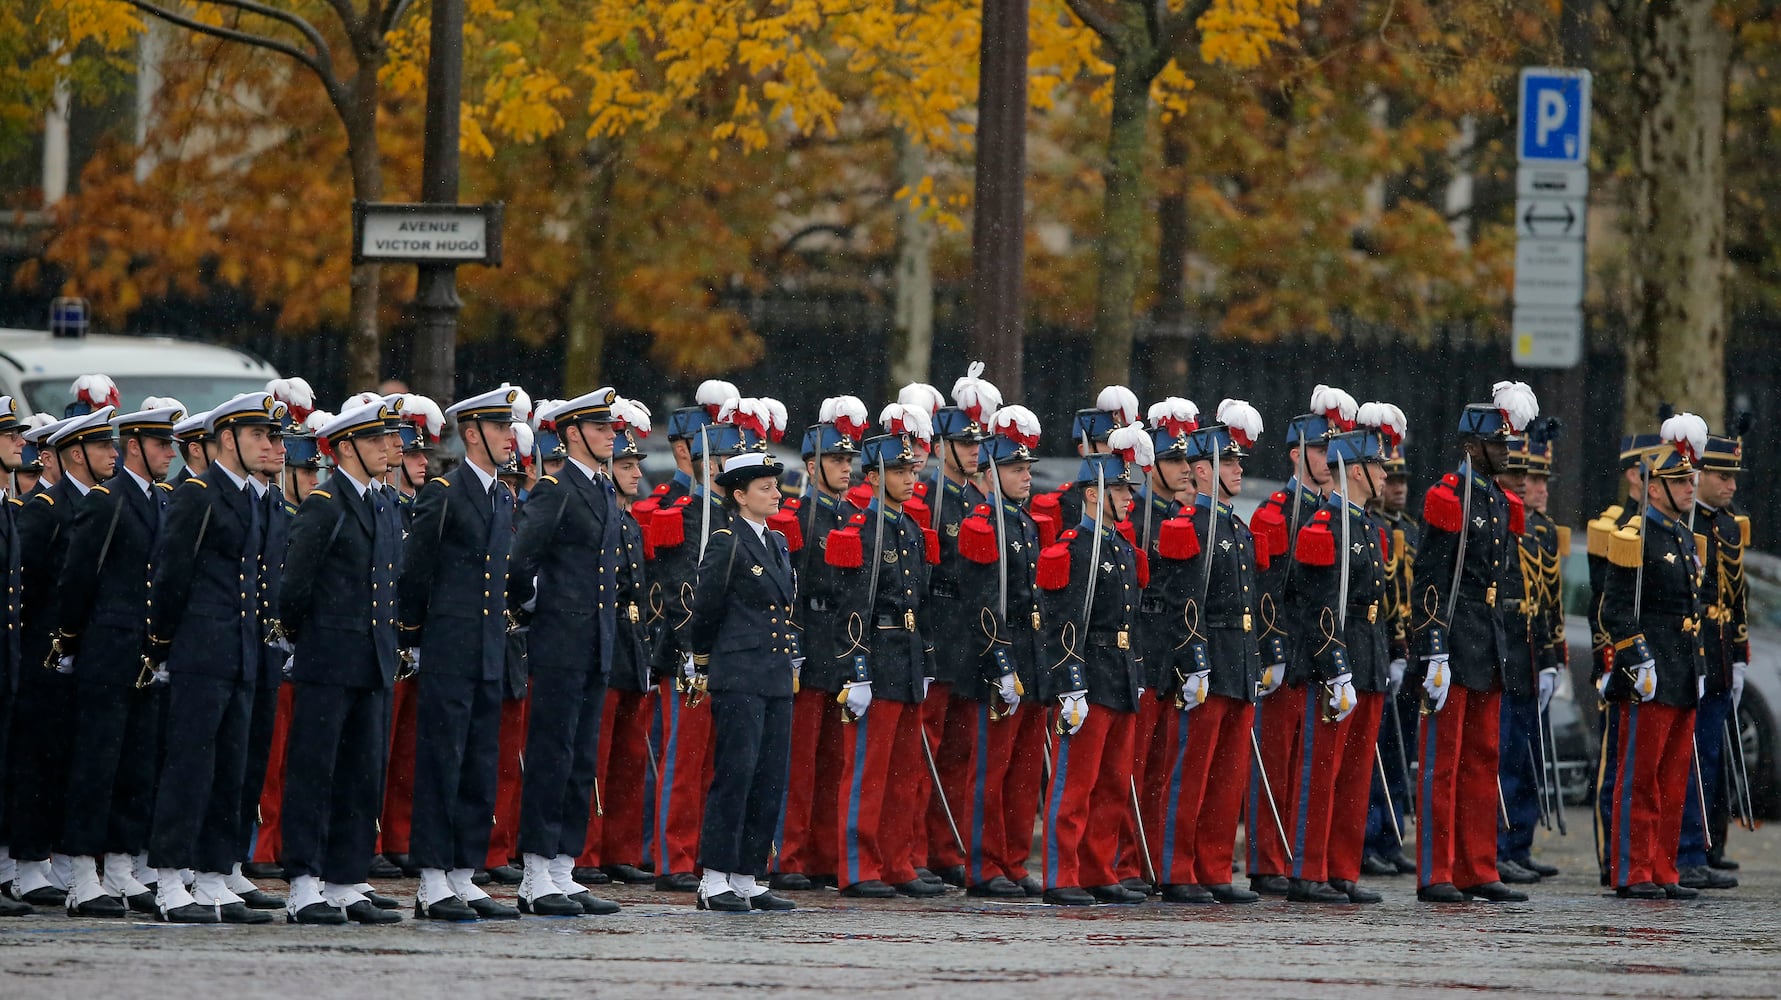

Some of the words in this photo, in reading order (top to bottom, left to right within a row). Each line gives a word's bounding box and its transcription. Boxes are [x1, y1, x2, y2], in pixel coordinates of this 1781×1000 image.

[1536, 88, 1567, 147] P
[398, 221, 460, 232] AVENUE
[376, 239, 430, 250] VICTOR
[436, 240, 479, 250] HUGO
